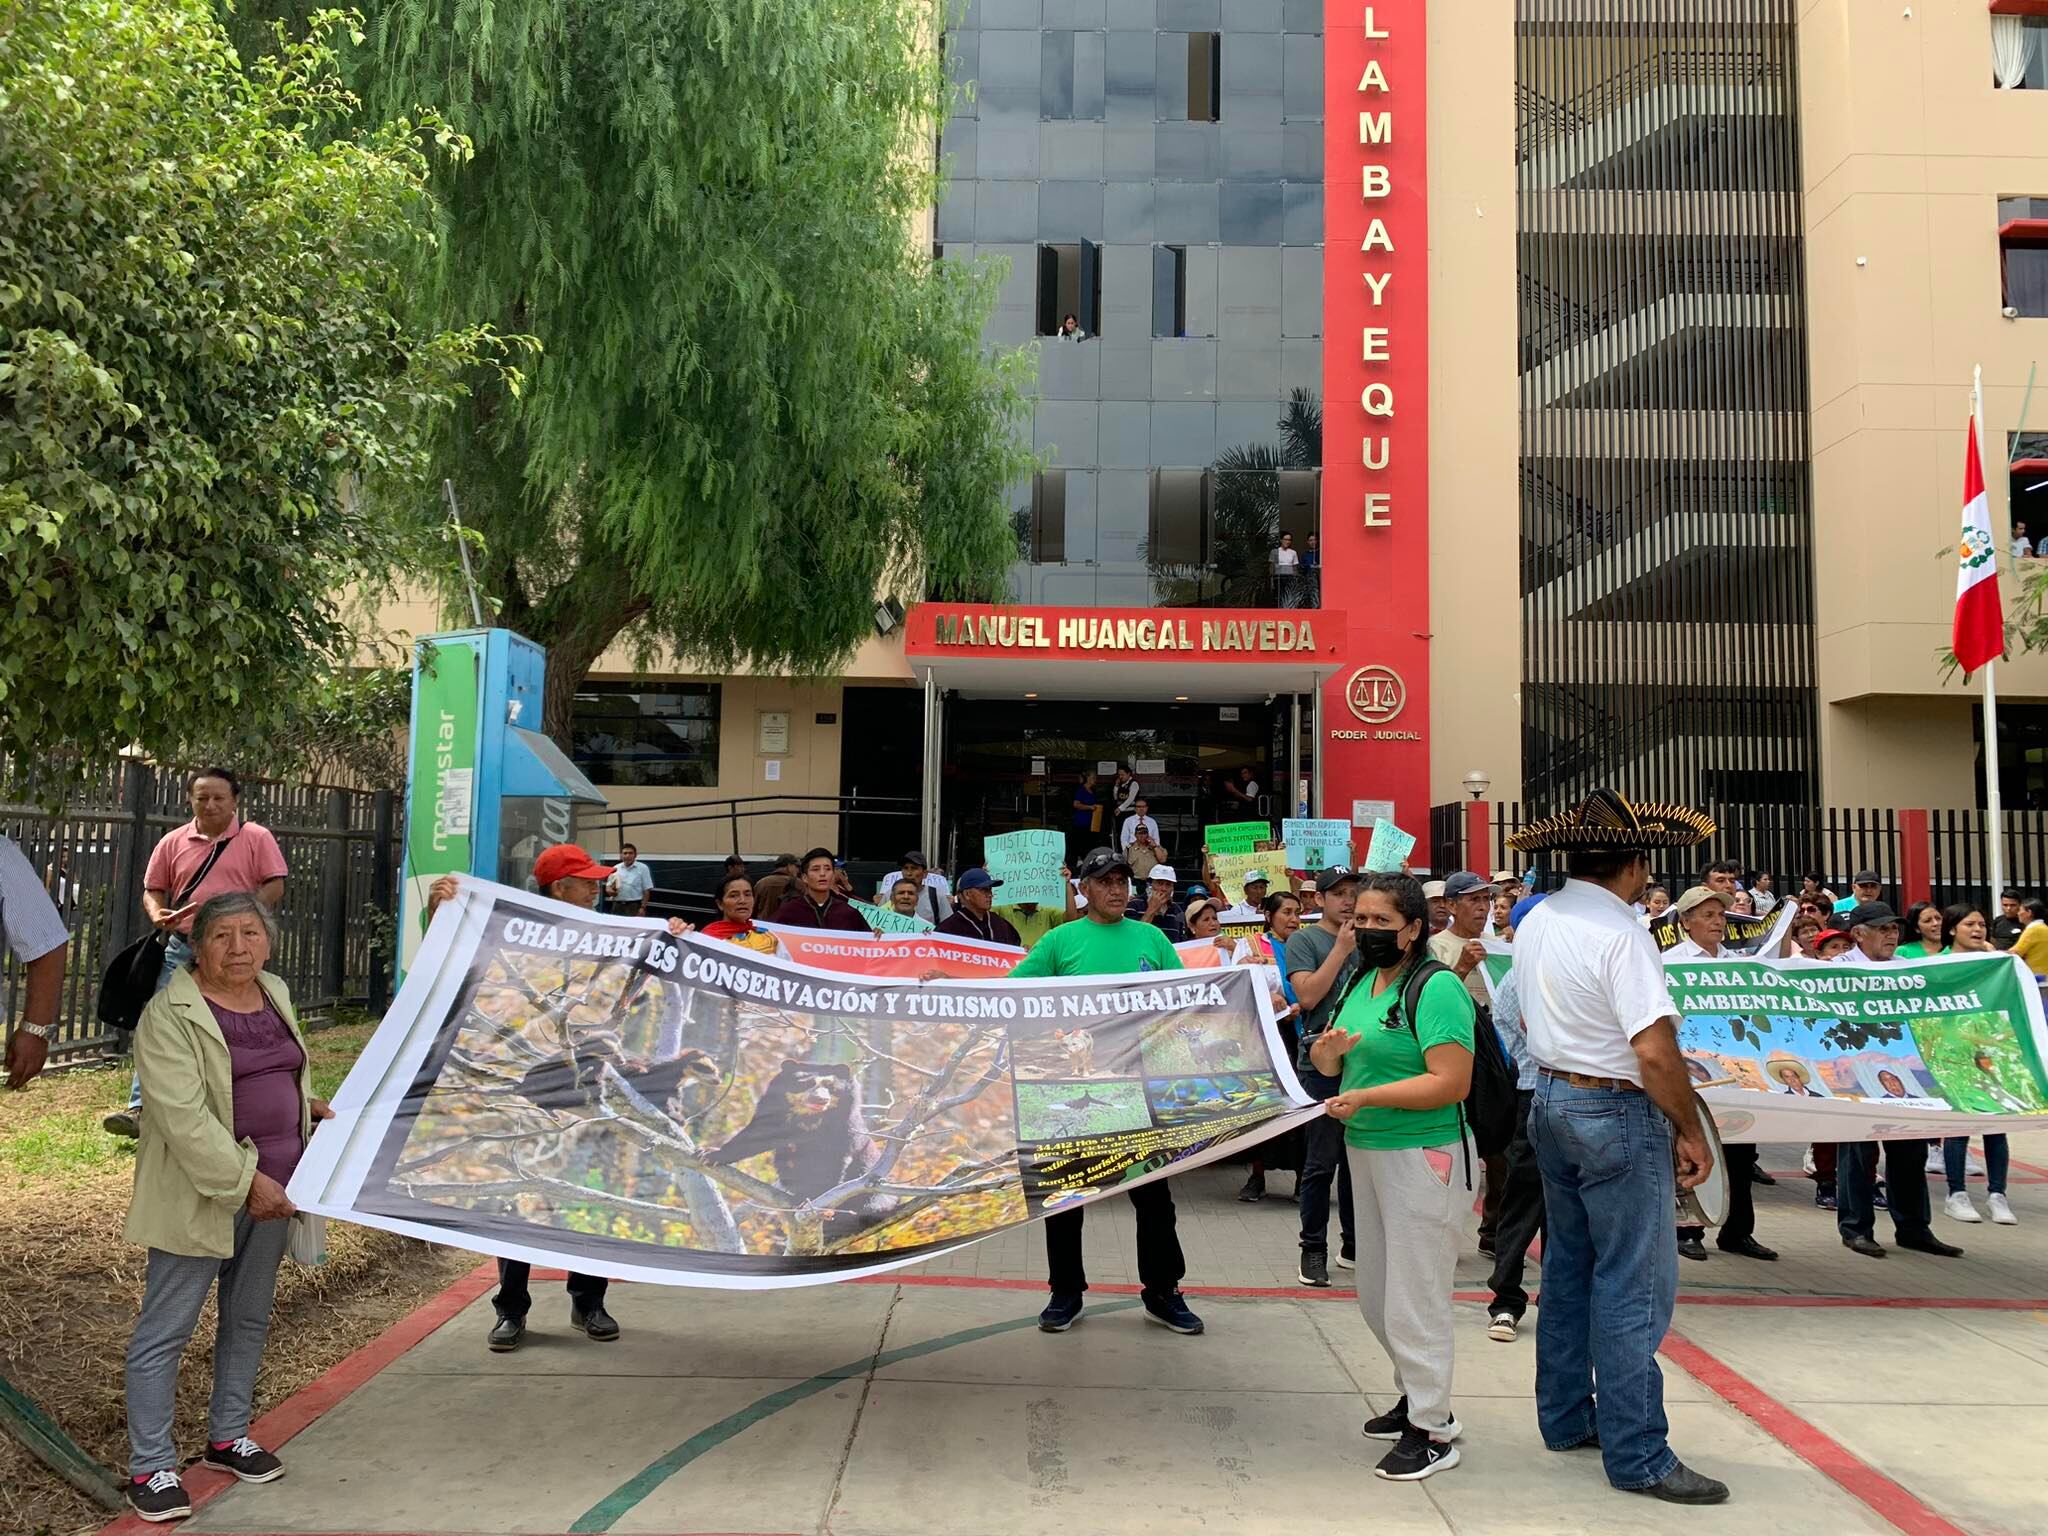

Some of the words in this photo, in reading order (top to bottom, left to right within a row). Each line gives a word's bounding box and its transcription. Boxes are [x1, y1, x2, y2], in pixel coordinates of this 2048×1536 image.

[1356, 6, 1395, 528] LAMBAYEQUE
[935, 614, 1051, 648] MANUEL
[1058, 617, 1194, 651] HUANGAL
[1202, 619, 1316, 652] NAVEDA
[1331, 730, 1367, 739] PODER
[1373, 730, 1421, 740] JUDICIAL
[990, 830, 1055, 853] JUSTICIA
[1005, 851, 1032, 864] PARA
[1036, 850, 1056, 866] LOS
[1657, 923, 1677, 946] LOS
[801, 942, 910, 958] COMUNIDAD
[915, 946, 1012, 969] CAMPESINA
[503, 916, 646, 960] CHAPARRÍ
[646, 940, 679, 973] ES
[682, 957, 878, 1013] CONSERVACIÓN
[884, 992, 900, 1014] Y
[904, 994, 1017, 1019] TURISMO
[1023, 996, 1057, 1018] DE
[1061, 983, 1227, 1017] NATURALEZA
[1682, 971, 1746, 987] PARA
[1750, 971, 1790, 987] LOS
[1789, 974, 1926, 994] COMUNEROS
[1682, 994, 1831, 1012] AMBIENTALES
[1828, 1001, 1859, 1017] DE
[1863, 990, 1983, 1016] CHAPARRÍ
[1118, 1129, 1164, 1141] bosques
